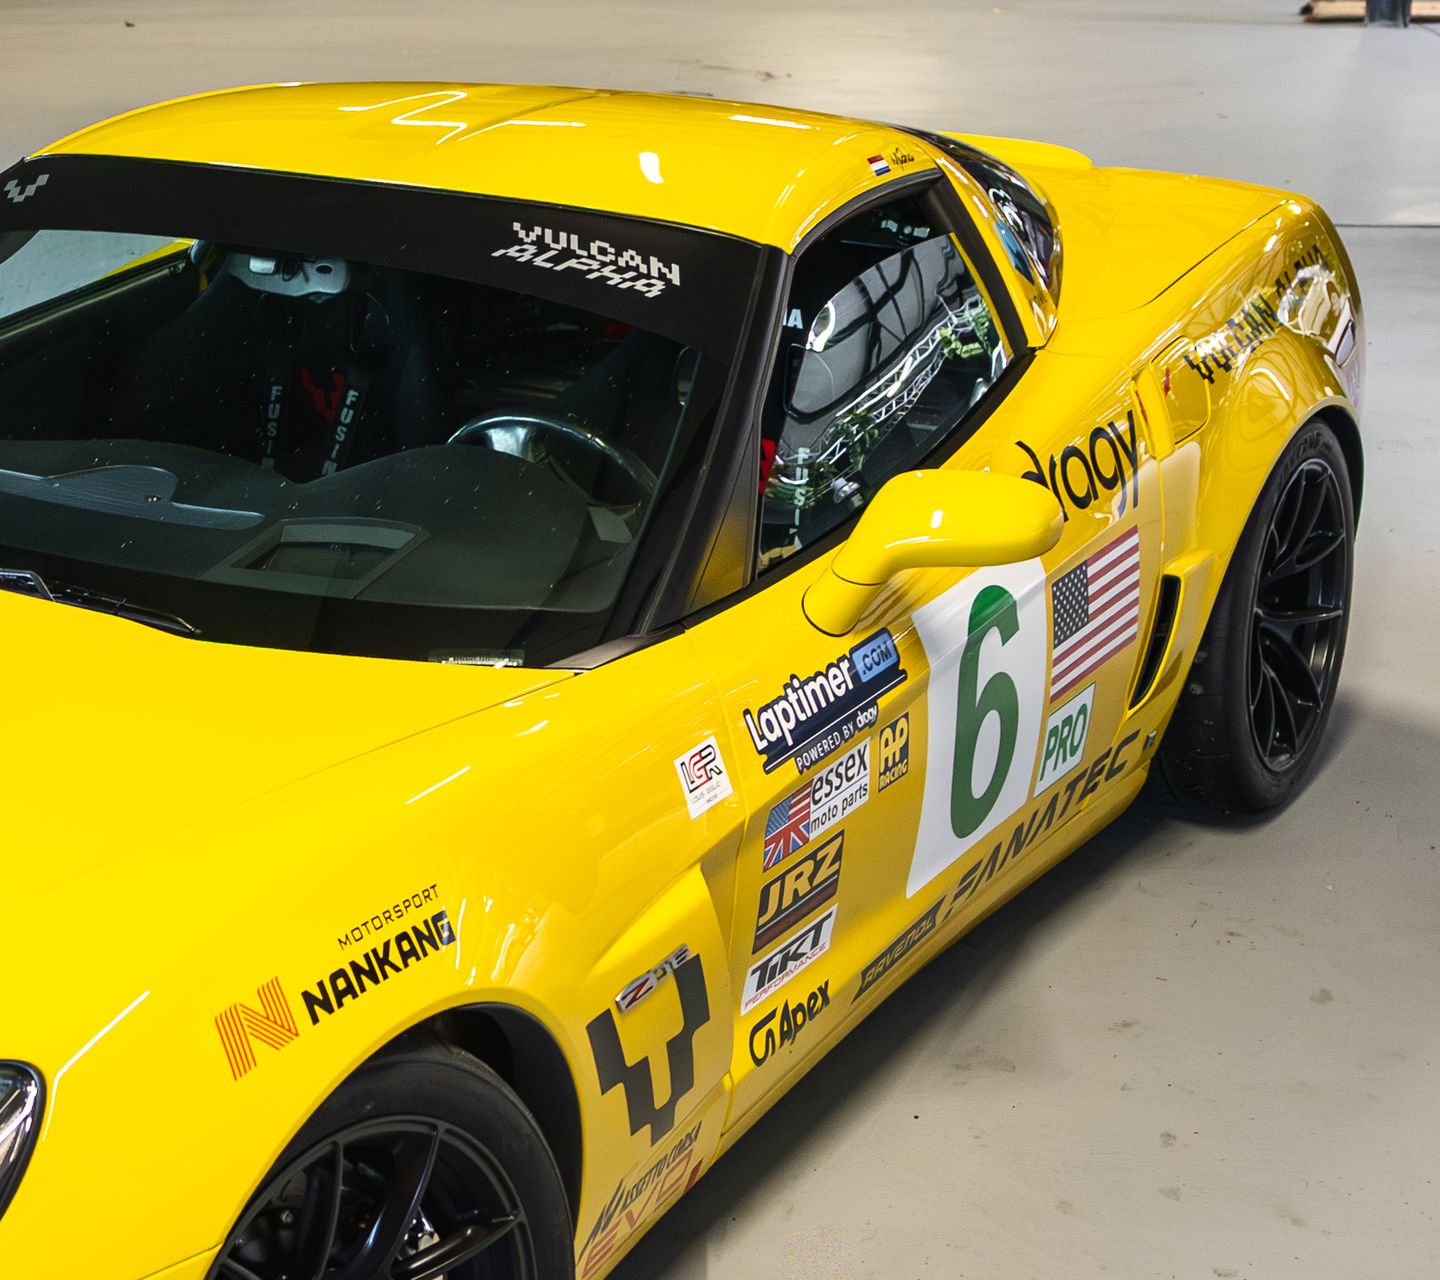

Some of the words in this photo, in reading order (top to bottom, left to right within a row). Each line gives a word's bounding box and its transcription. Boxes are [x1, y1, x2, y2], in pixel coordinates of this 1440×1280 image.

[491, 244, 666, 298] ALPHA
[513, 222, 681, 286] VULCAN
[745, 658, 855, 751] Laptimer
[950, 584, 1020, 839] 6
[796, 732, 841, 770] POWERED
[842, 721, 855, 739] BY
[811, 743, 869, 805] essex
[879, 759, 908, 788] RACING
[880, 717, 908, 773] AP
[1039, 703, 1088, 782] PRO
[810, 804, 838, 833] moto
[841, 783, 868, 816] parts
[941, 729, 1141, 924] FANATEC
[758, 836, 844, 927] JRZ
[338, 884, 440, 950] MOTORSPORT
[301, 910, 456, 1026] NANKANG
[744, 942, 827, 1009] PERFORMANCE
